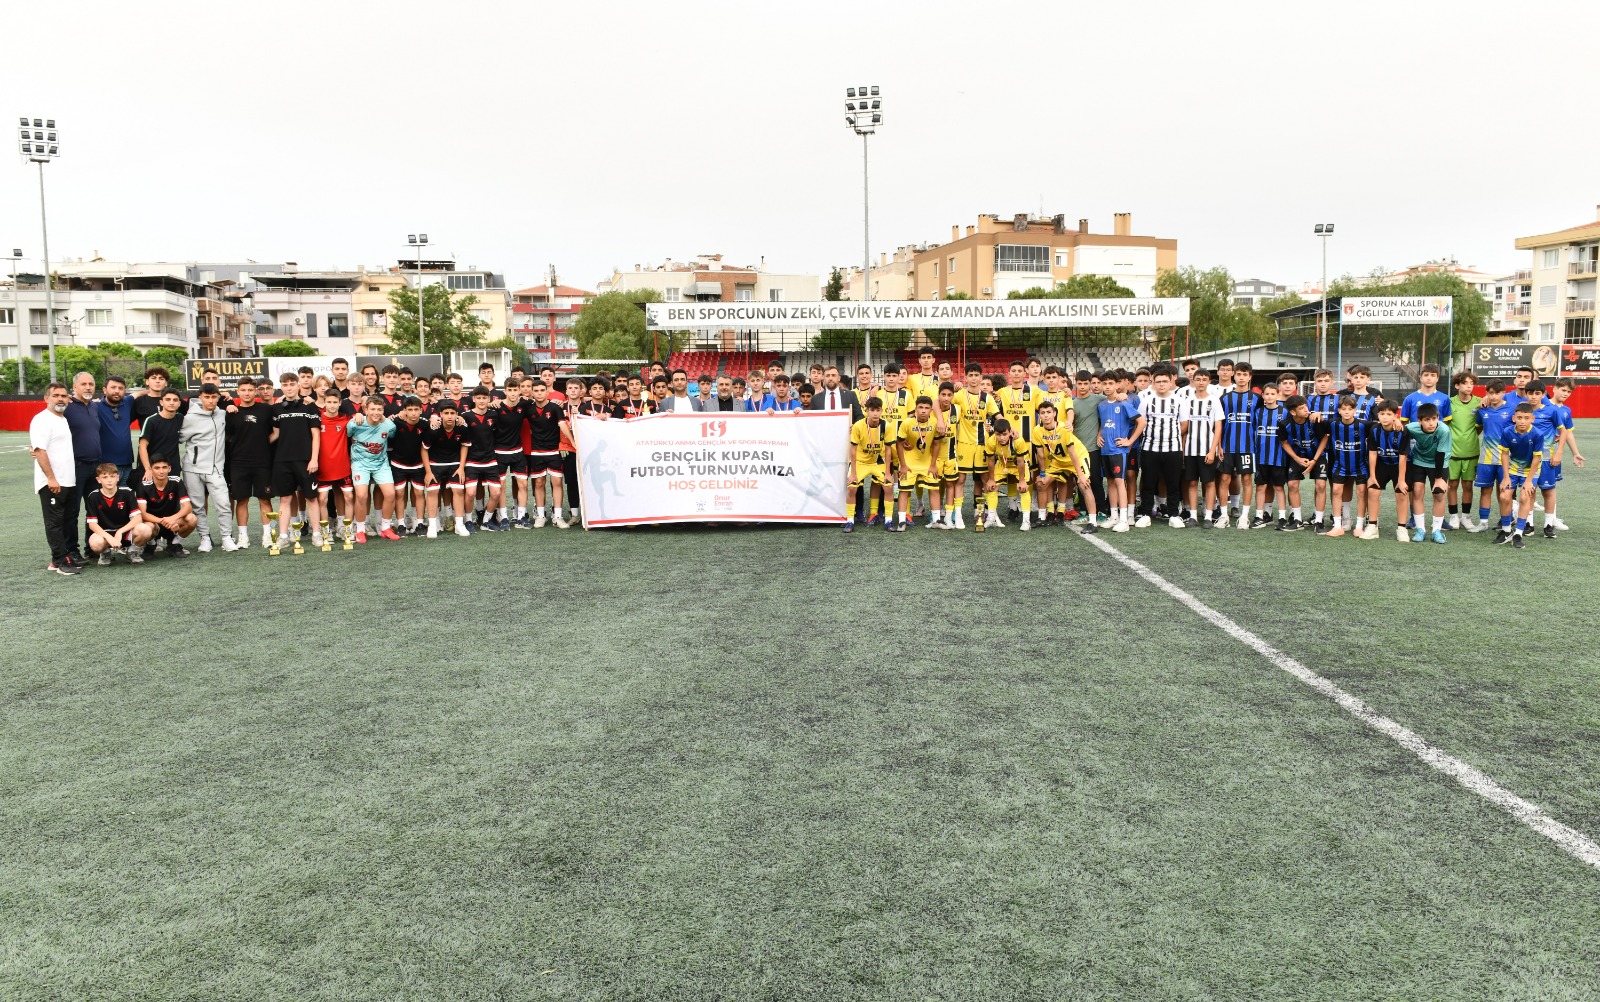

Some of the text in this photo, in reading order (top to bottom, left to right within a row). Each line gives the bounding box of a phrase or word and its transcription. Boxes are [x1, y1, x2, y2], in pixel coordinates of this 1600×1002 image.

[1360, 300, 1397, 308] SPORUN
[668, 308, 695, 320] BEN
[699, 307, 787, 320] SPORCUNUN
[791, 304, 825, 320] ZEKİ,
[829, 304, 871, 322] ÇEVİK
[873, 306, 891, 319] VE
[894, 306, 928, 319] AYNI
[930, 306, 1005, 318] ZAMANDA
[1008, 304, 1098, 317] AHLAKLISINI
[1102, 301, 1164, 316] SEVERİM
[1396, 309, 1429, 317] ATIYOR
[1494, 347, 1523, 357] SINAN
[208, 361, 264, 375] MURAT
[651, 449, 774, 465] GENÇLİK KUPASI
[1241, 454, 1251, 464] 16
[630, 464, 795, 478] FUTBOL TURNUVAMIZA
[668, 477, 758, 492] HOŞ GELDİNİZ
